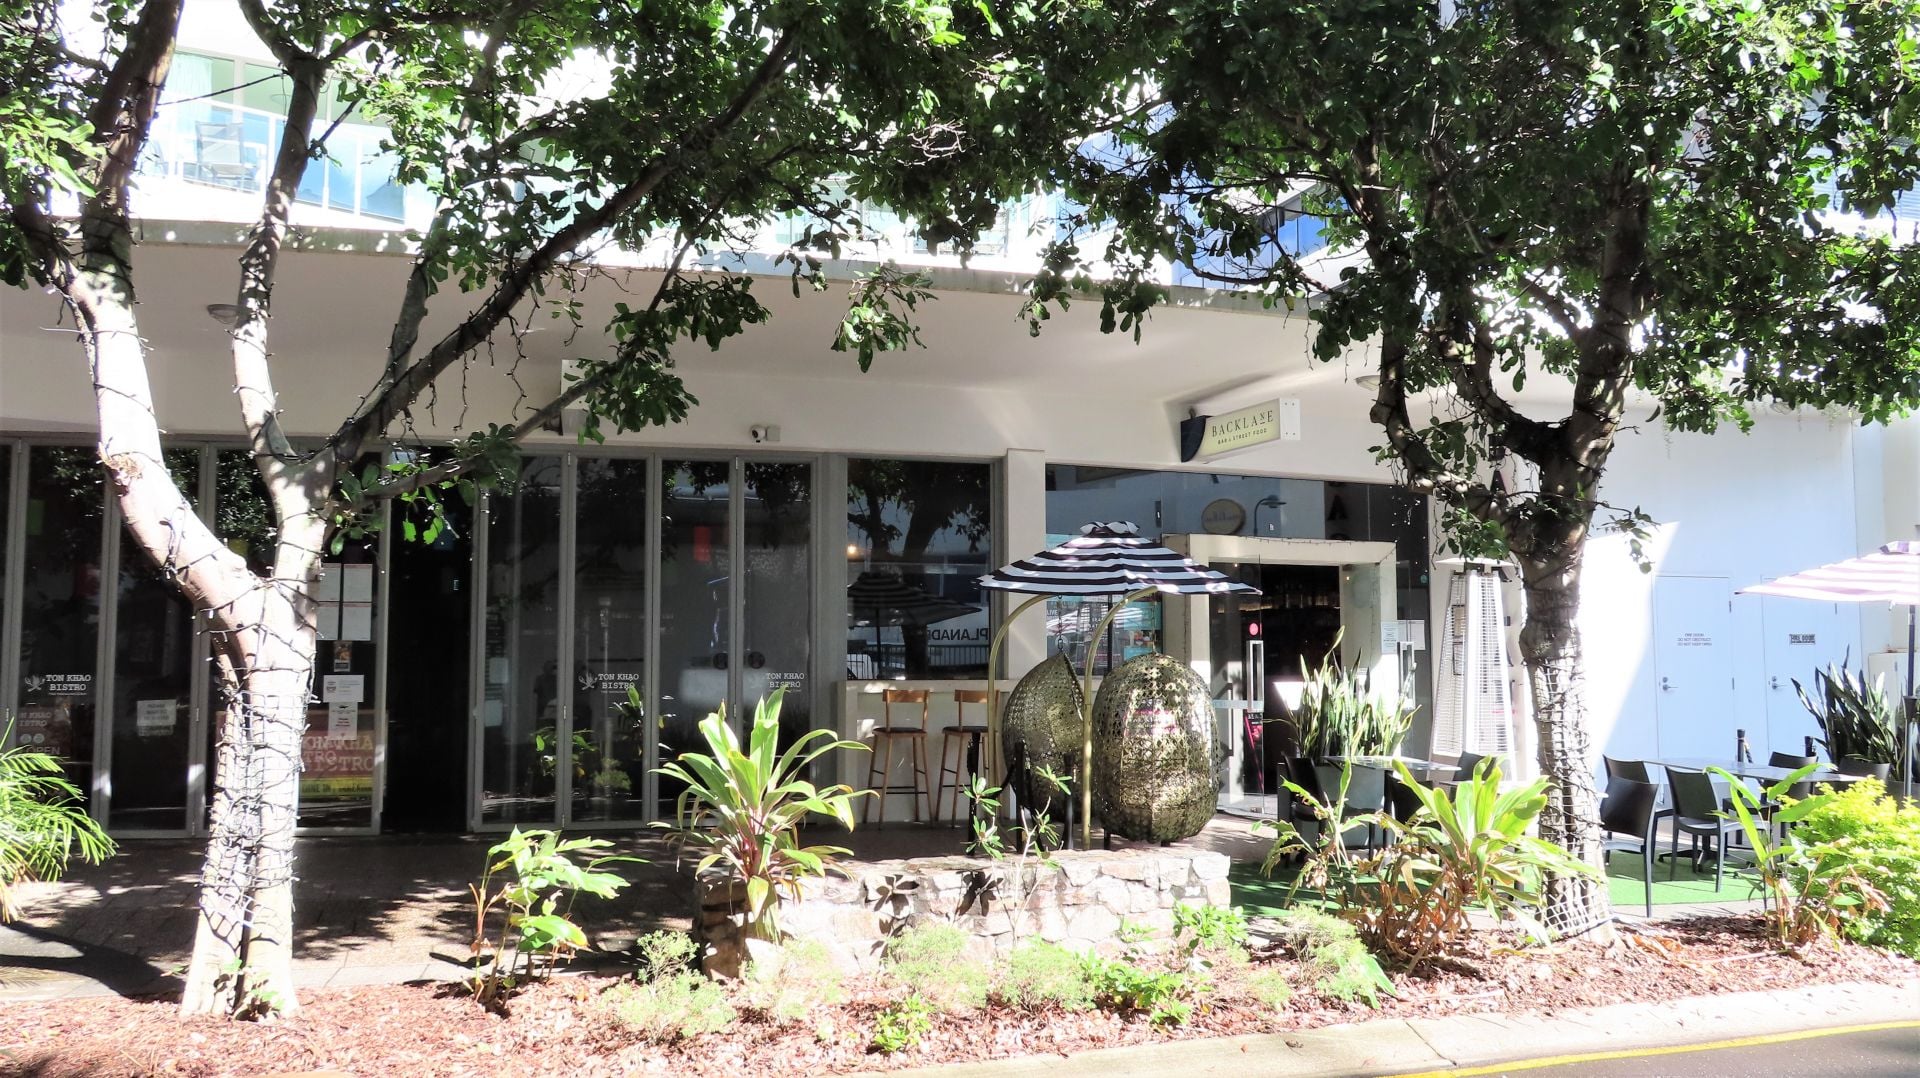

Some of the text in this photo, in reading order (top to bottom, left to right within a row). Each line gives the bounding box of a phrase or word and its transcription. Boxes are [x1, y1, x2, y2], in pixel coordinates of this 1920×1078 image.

[1212, 410, 1274, 437] BACKLANE
[1233, 431, 1251, 441] STREET
[45, 674, 92, 682] TON KHAO
[784, 672, 805, 680] KHAO
[49, 683, 87, 691] BISTRO
